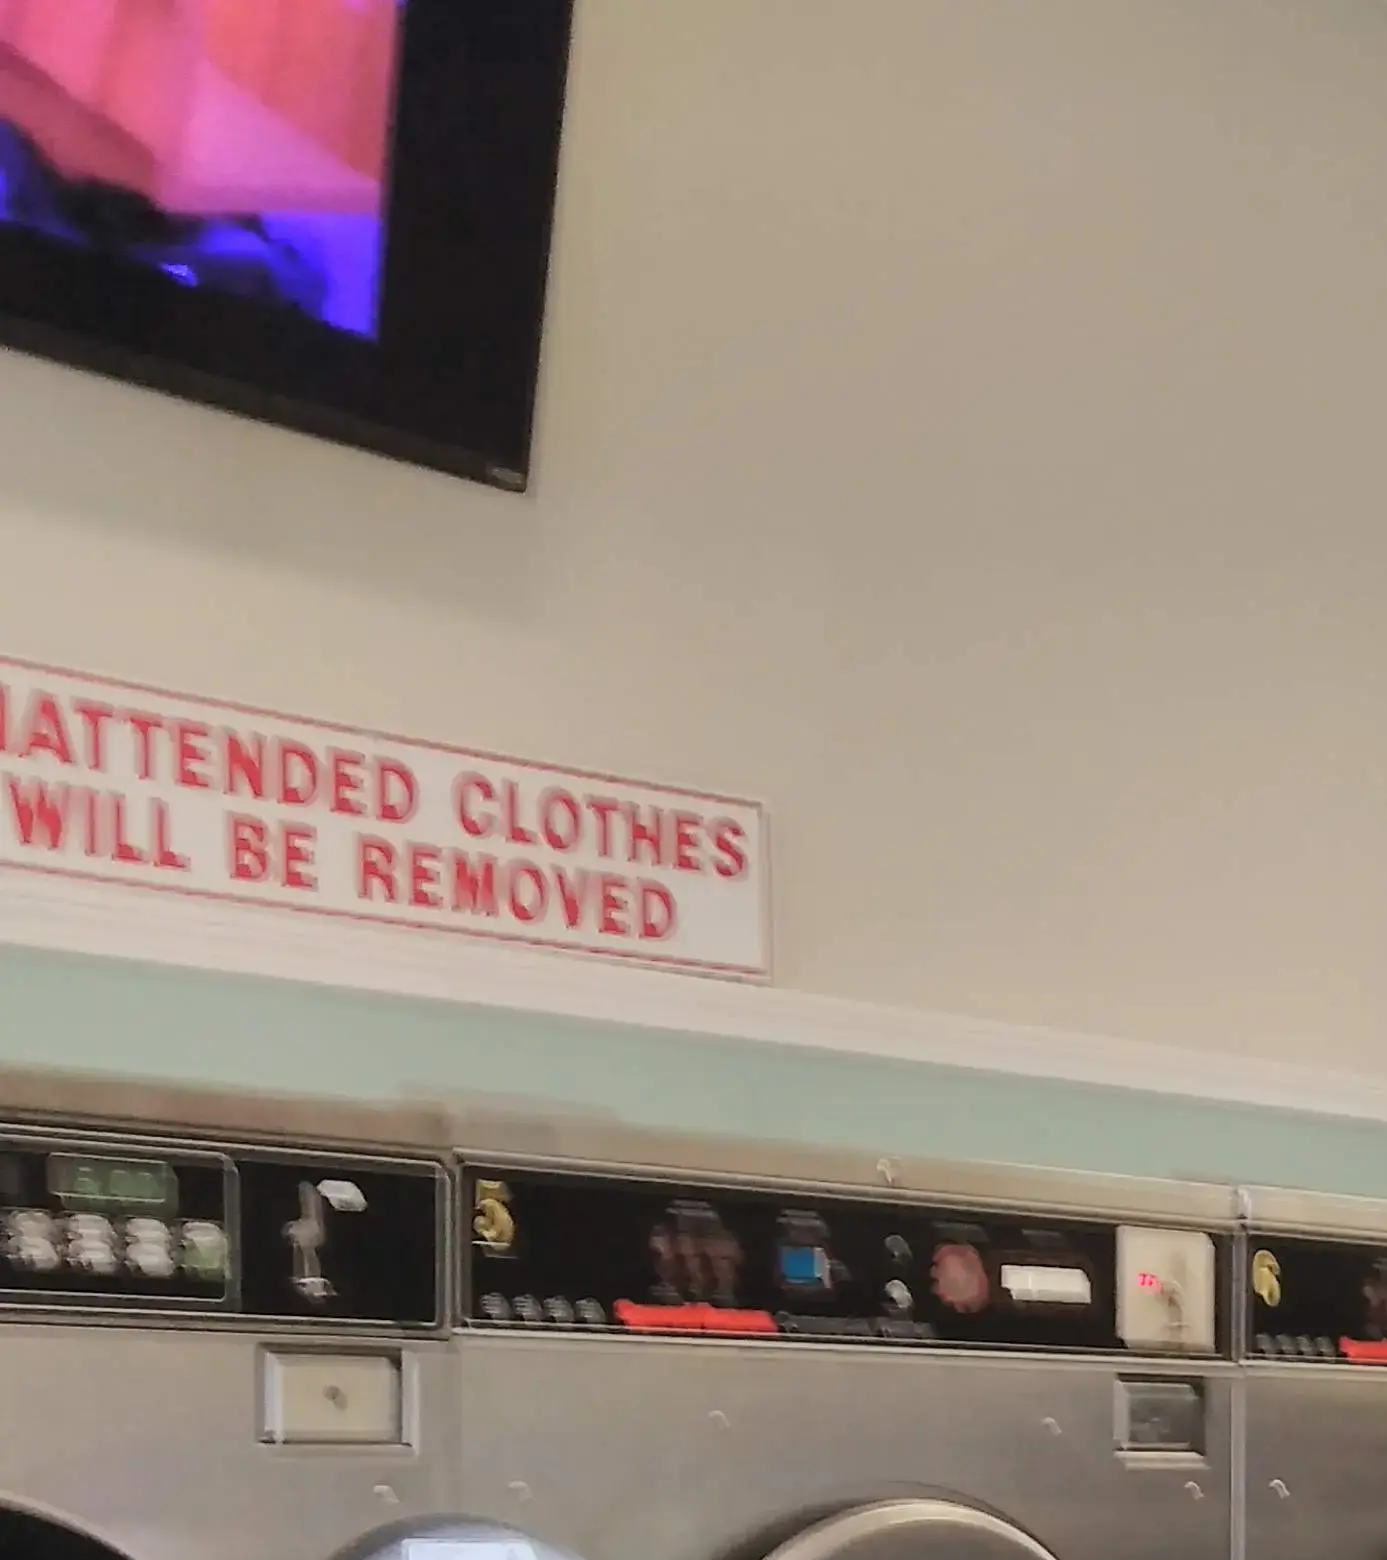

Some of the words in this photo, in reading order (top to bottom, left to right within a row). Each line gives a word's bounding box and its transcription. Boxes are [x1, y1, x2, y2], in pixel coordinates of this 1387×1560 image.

[2, 771, 192, 869] WILL
[222, 810, 319, 890] BE
[354, 831, 678, 941] REMOVED
[452, 771, 749, 882] CLOTHES
